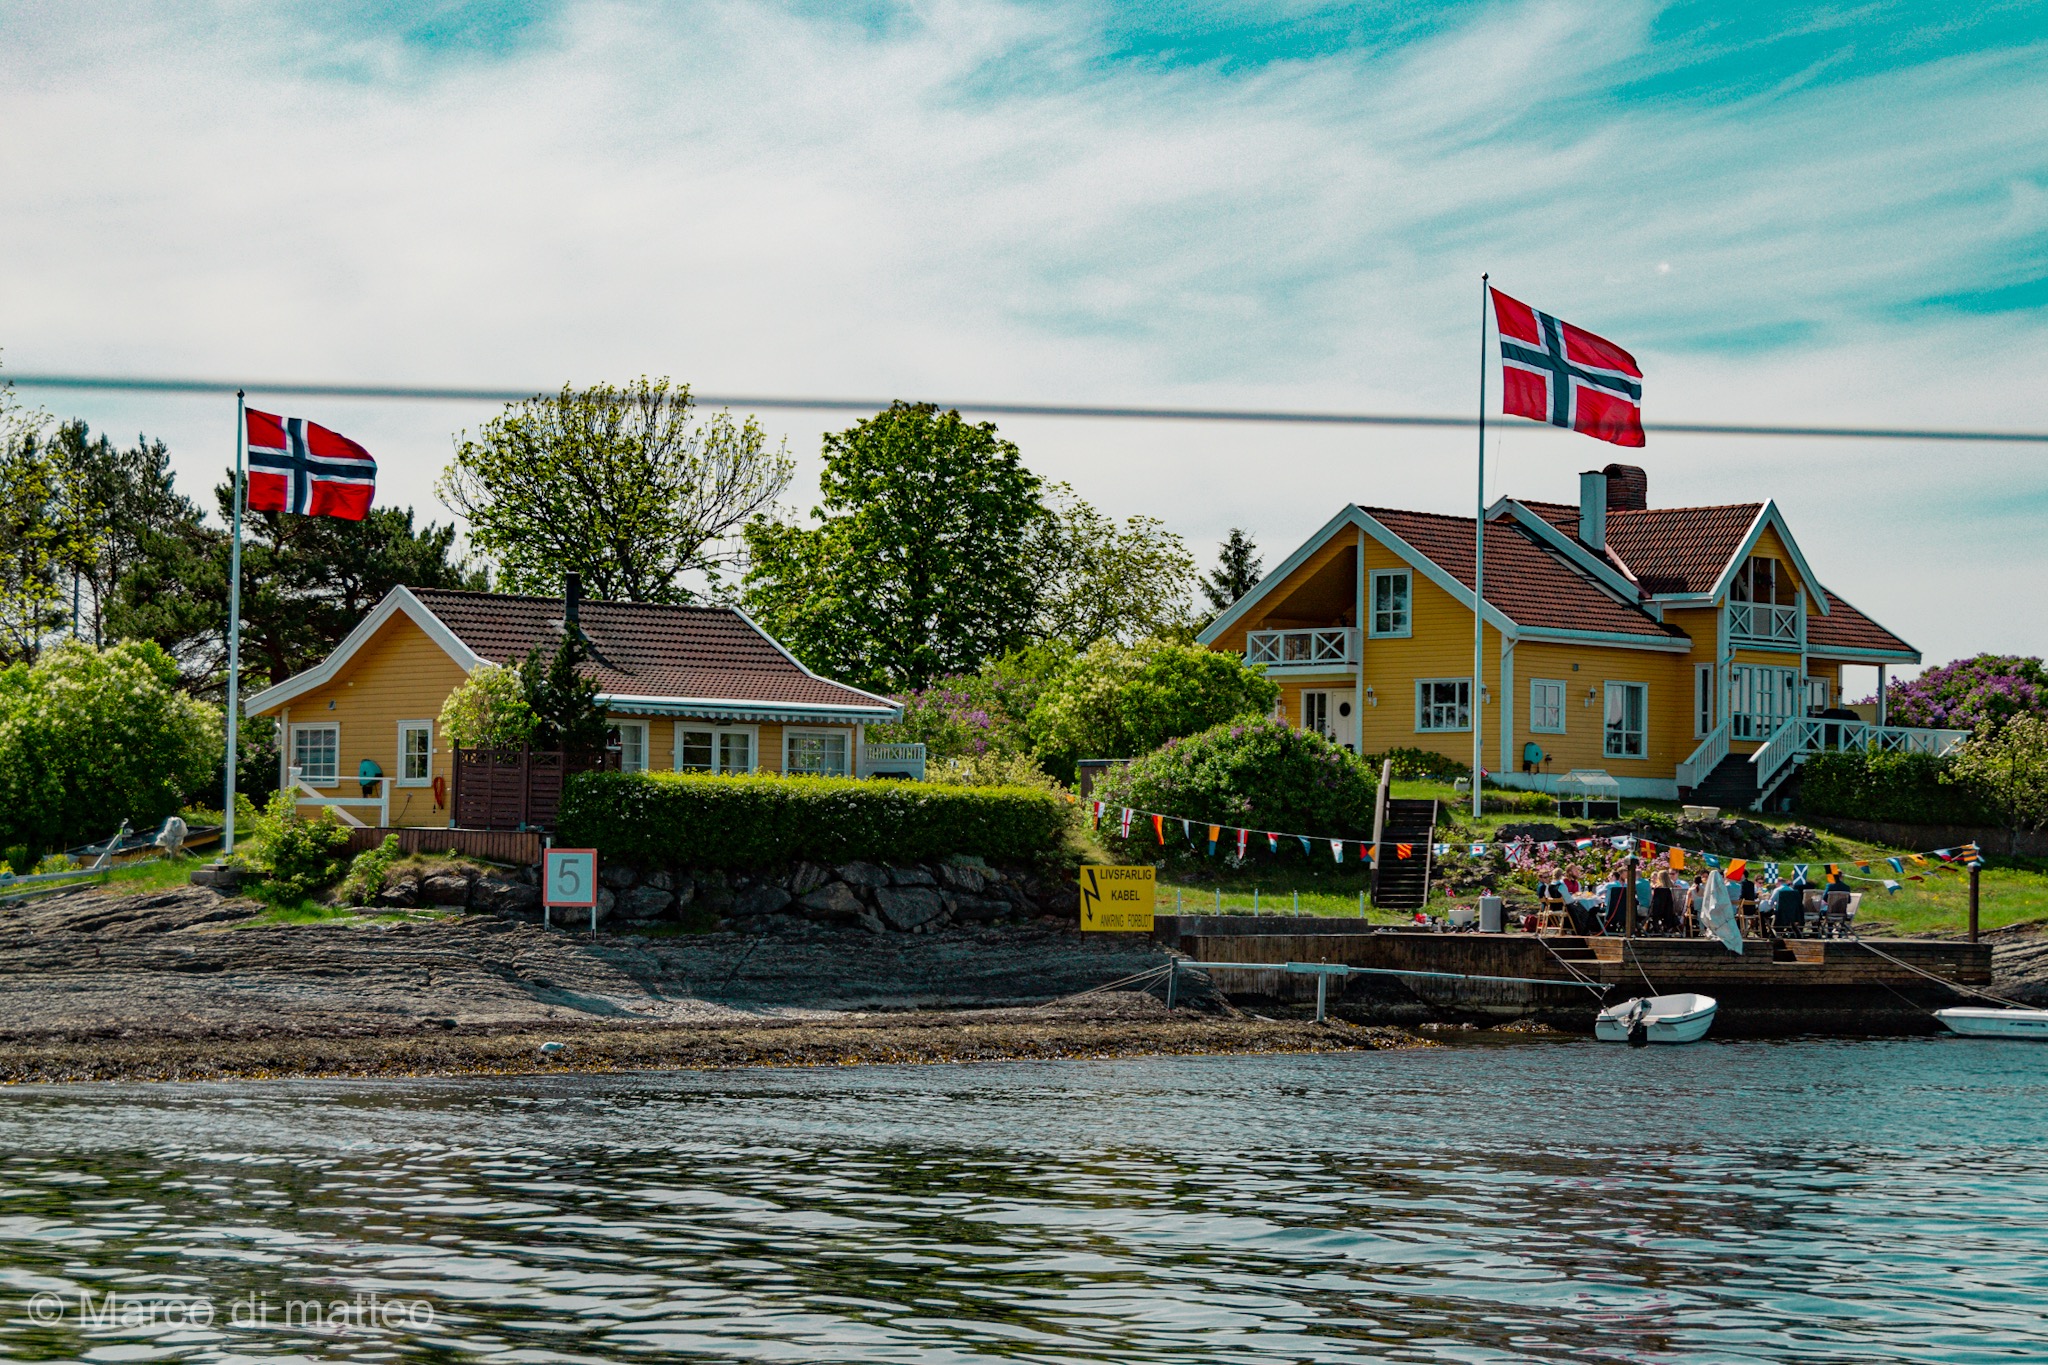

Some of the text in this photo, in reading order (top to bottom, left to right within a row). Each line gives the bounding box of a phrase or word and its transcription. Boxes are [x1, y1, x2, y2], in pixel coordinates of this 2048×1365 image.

[557, 858, 580, 896] 5
[1100, 869, 1152, 880] LIVSFARLIG
[1111, 890, 1140, 901] KABEL
[1101, 914, 1152, 928] ANKRING FORBUDT
